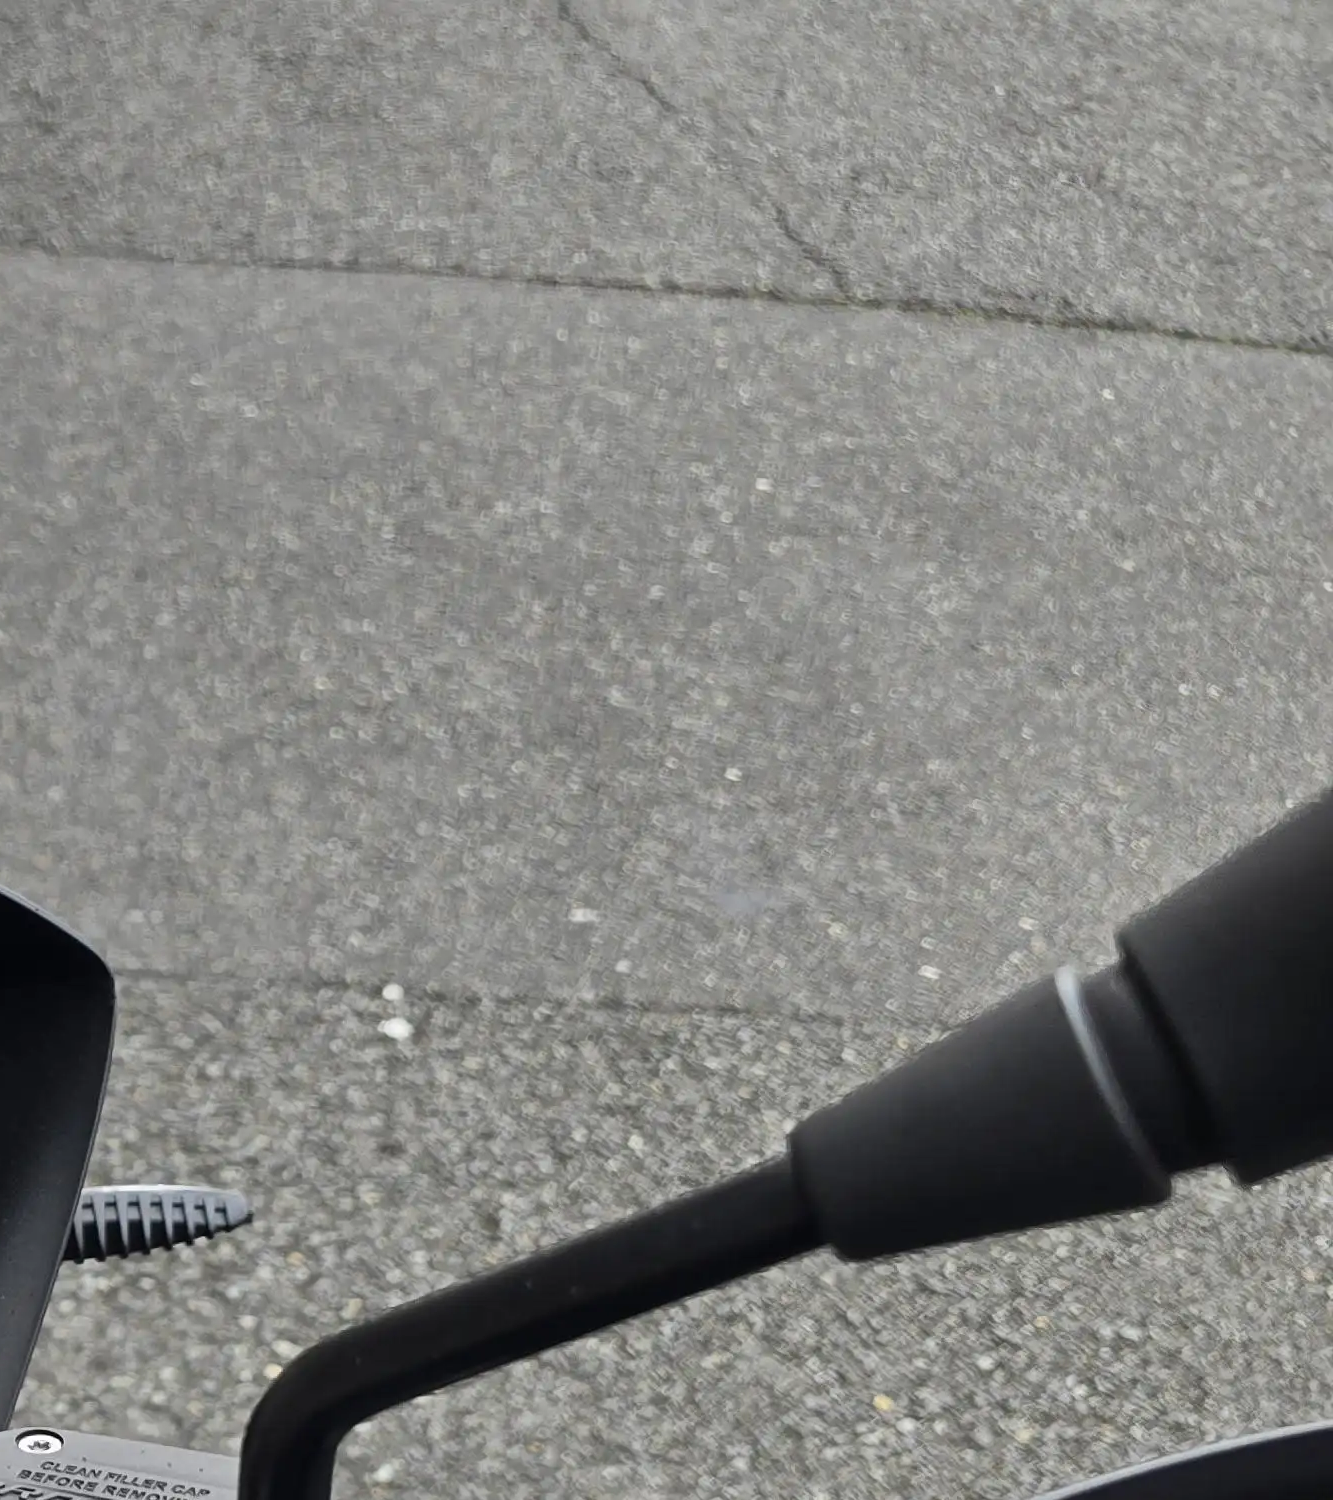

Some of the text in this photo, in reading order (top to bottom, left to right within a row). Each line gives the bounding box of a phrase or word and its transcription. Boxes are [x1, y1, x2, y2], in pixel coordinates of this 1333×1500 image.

[17, 1469, 99, 1492] BEFORE
[40, 1461, 211, 1497] CLEAN FILLER CAP
